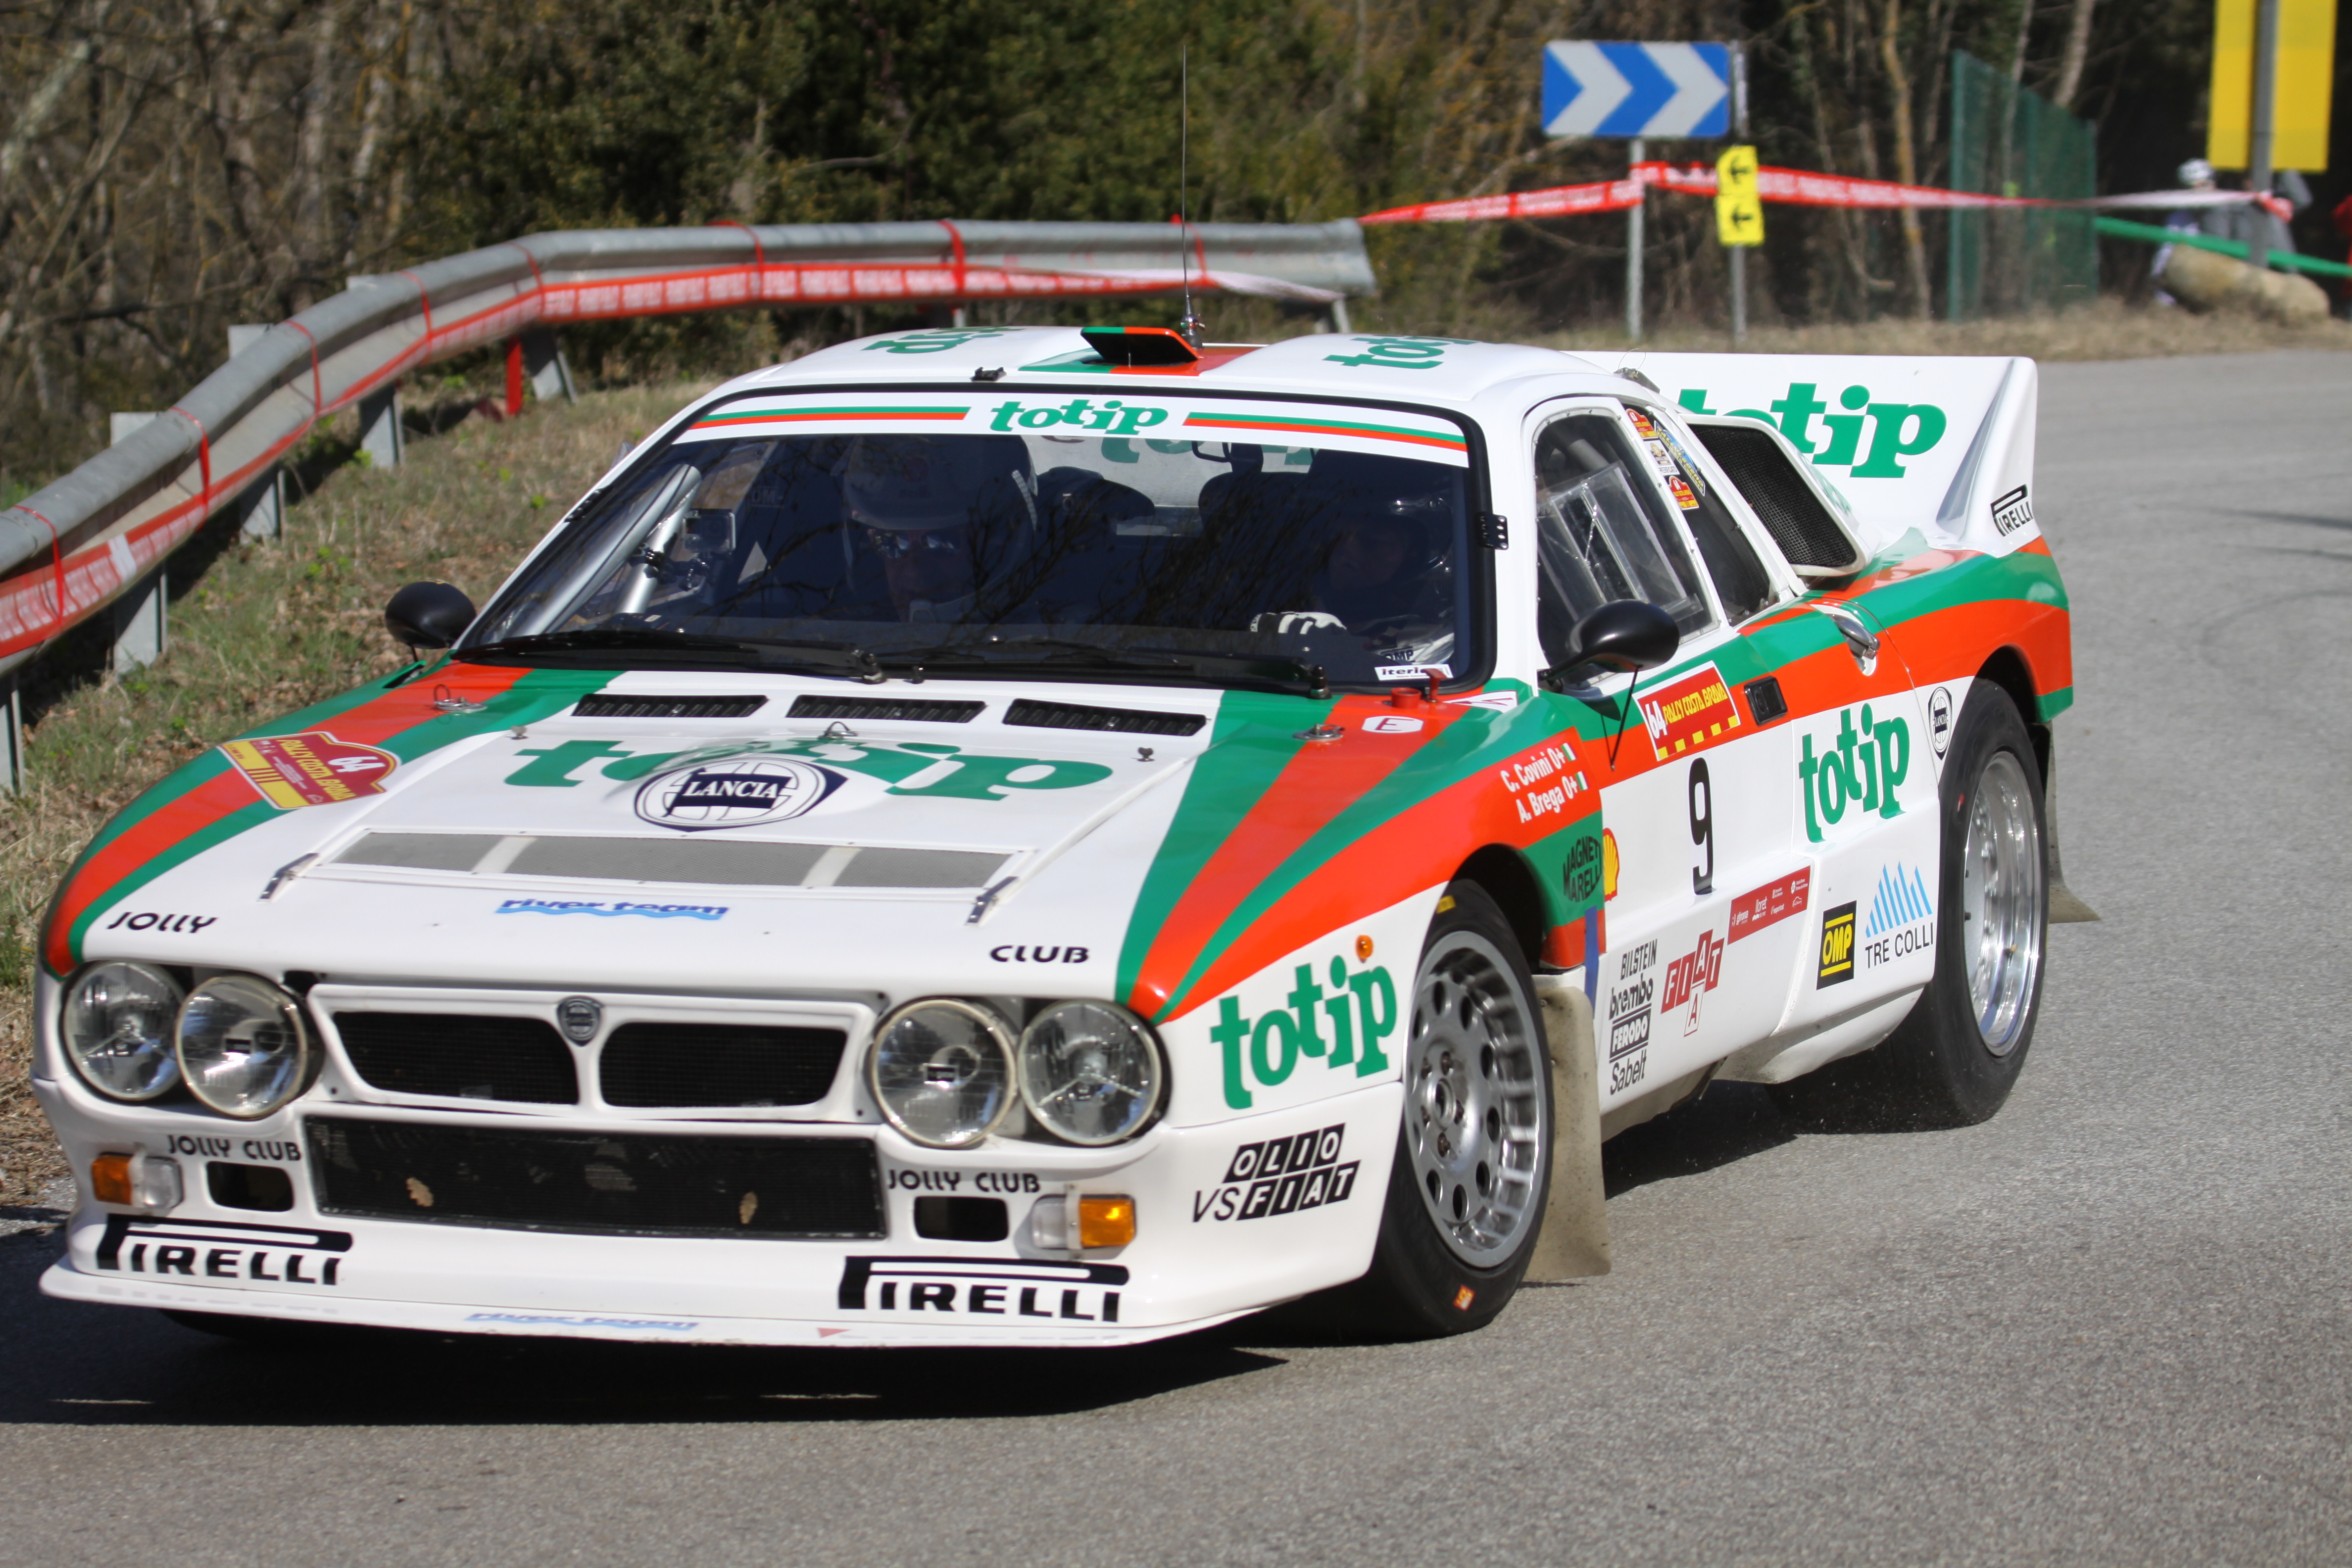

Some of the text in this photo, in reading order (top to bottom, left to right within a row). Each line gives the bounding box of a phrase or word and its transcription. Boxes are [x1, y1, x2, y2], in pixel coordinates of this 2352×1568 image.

[990, 399, 1169, 435] totip
[1990, 484, 2034, 537] PIRELLI
[1374, 717, 1414, 732] E
[1645, 682, 1728, 739] 64 RALLY COSTA BRAVA
[276, 739, 317, 758] RALLY
[296, 759, 335, 779] COSTA
[327, 756, 386, 773] 64
[314, 779, 357, 800] BRAVA
[682, 780, 779, 798] LANCIA
[1500, 770, 1521, 792] C.
[1513, 751, 1555, 786] Covini
[1799, 703, 1910, 843] totip
[1516, 798, 1532, 823] A.
[1527, 786, 1566, 813] Brega
[1688, 757, 1714, 895] 9
[106, 912, 218, 933] JOLLY
[502, 898, 730, 915] river team
[990, 944, 1088, 963] CLUB
[1620, 938, 1658, 980] BILSTEIN
[1823, 924, 1852, 965] OMP
[1864, 922, 1934, 969] TRE COLLI
[1664, 935, 1722, 1009] FIAT
[1609, 973, 1654, 1021] brembo
[1210, 955, 1397, 1109] totip
[1612, 1014, 1649, 1053] FERODO
[1610, 1048, 1647, 1095] Sabelt
[168, 1134, 301, 1161] JOLLY CLUB
[1230, 1129, 1341, 1179] OLIO
[887, 1170, 1041, 1193] JOLLY CLUB
[1192, 1165, 1356, 1223] VS FIAT
[96, 1214, 353, 1285] PIRELLI
[838, 1256, 1129, 1323] PIRELLI
